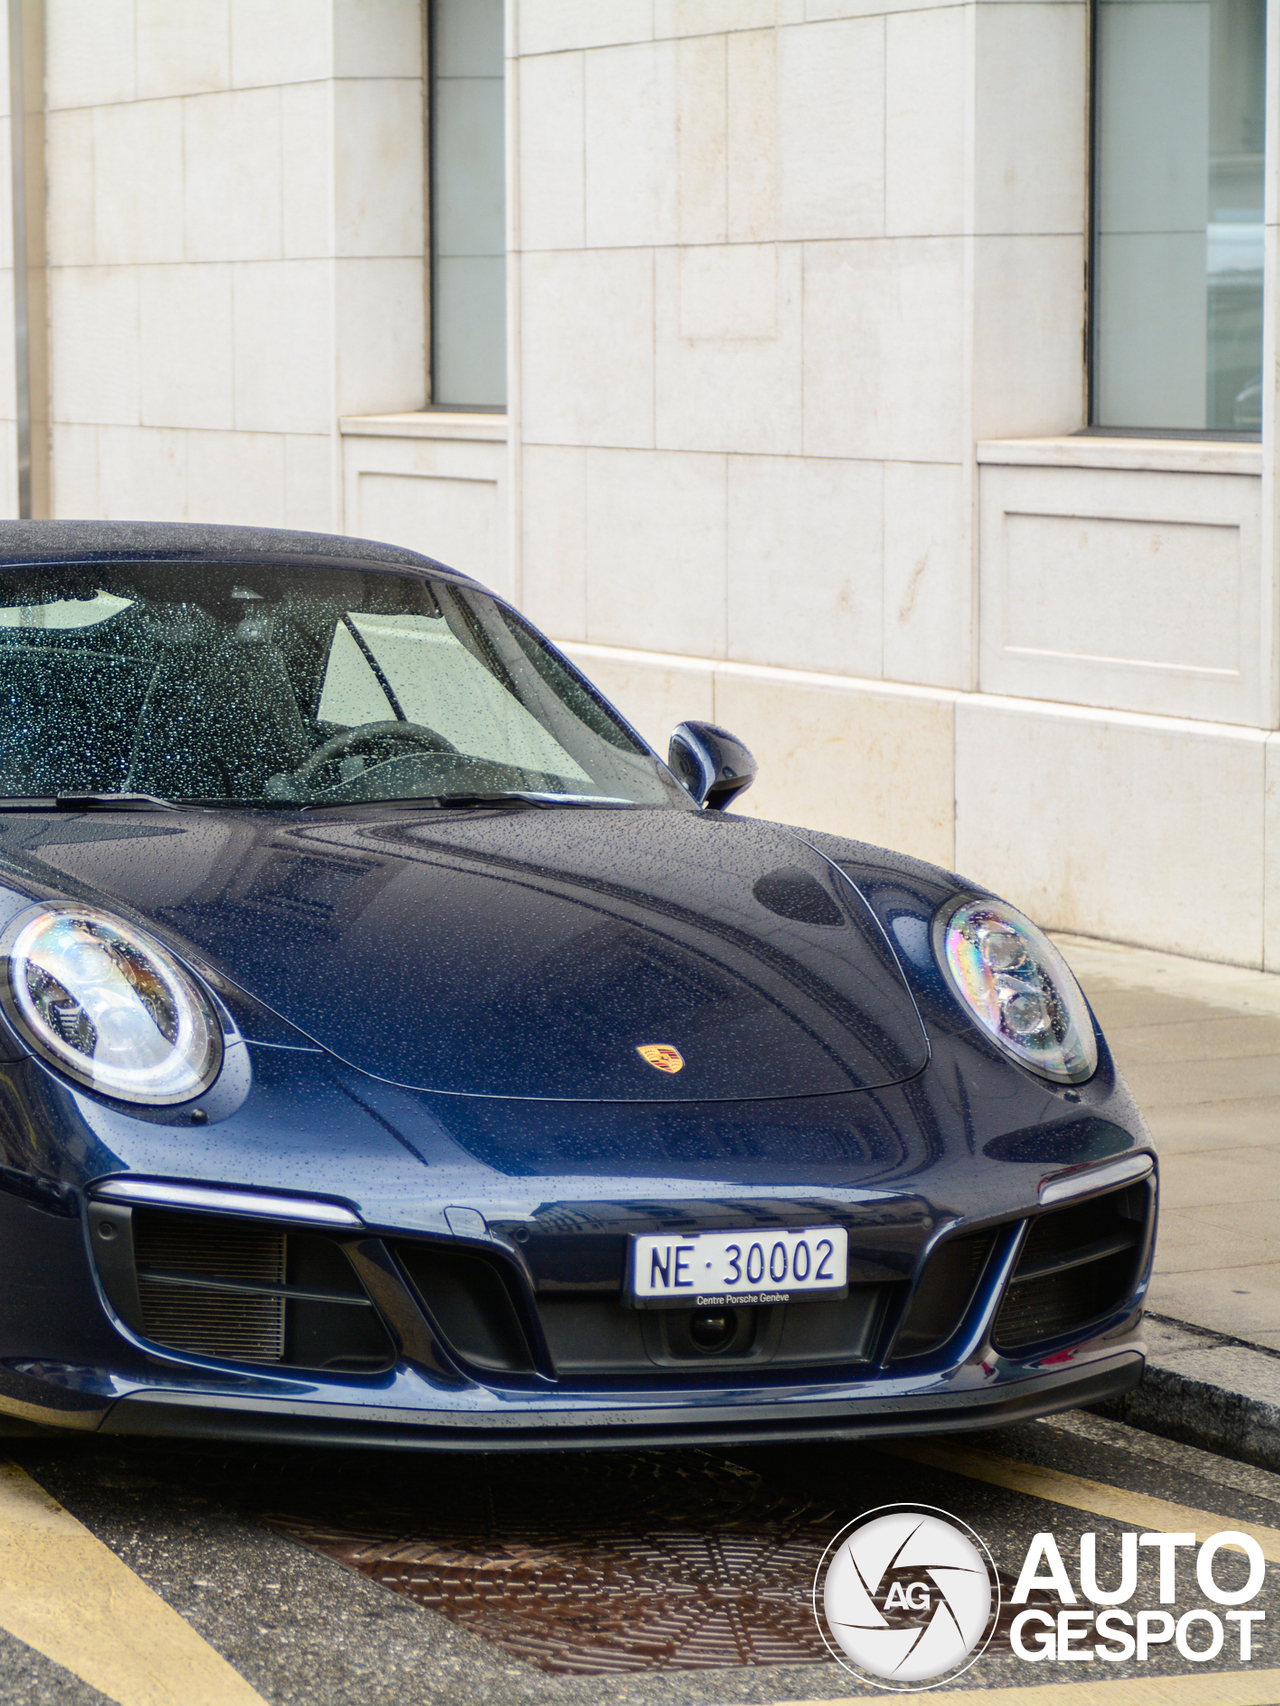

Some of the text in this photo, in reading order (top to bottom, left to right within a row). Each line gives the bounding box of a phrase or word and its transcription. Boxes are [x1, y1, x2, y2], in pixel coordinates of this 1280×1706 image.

[696, 1292, 790, 1306] Centre Porsche Genève
